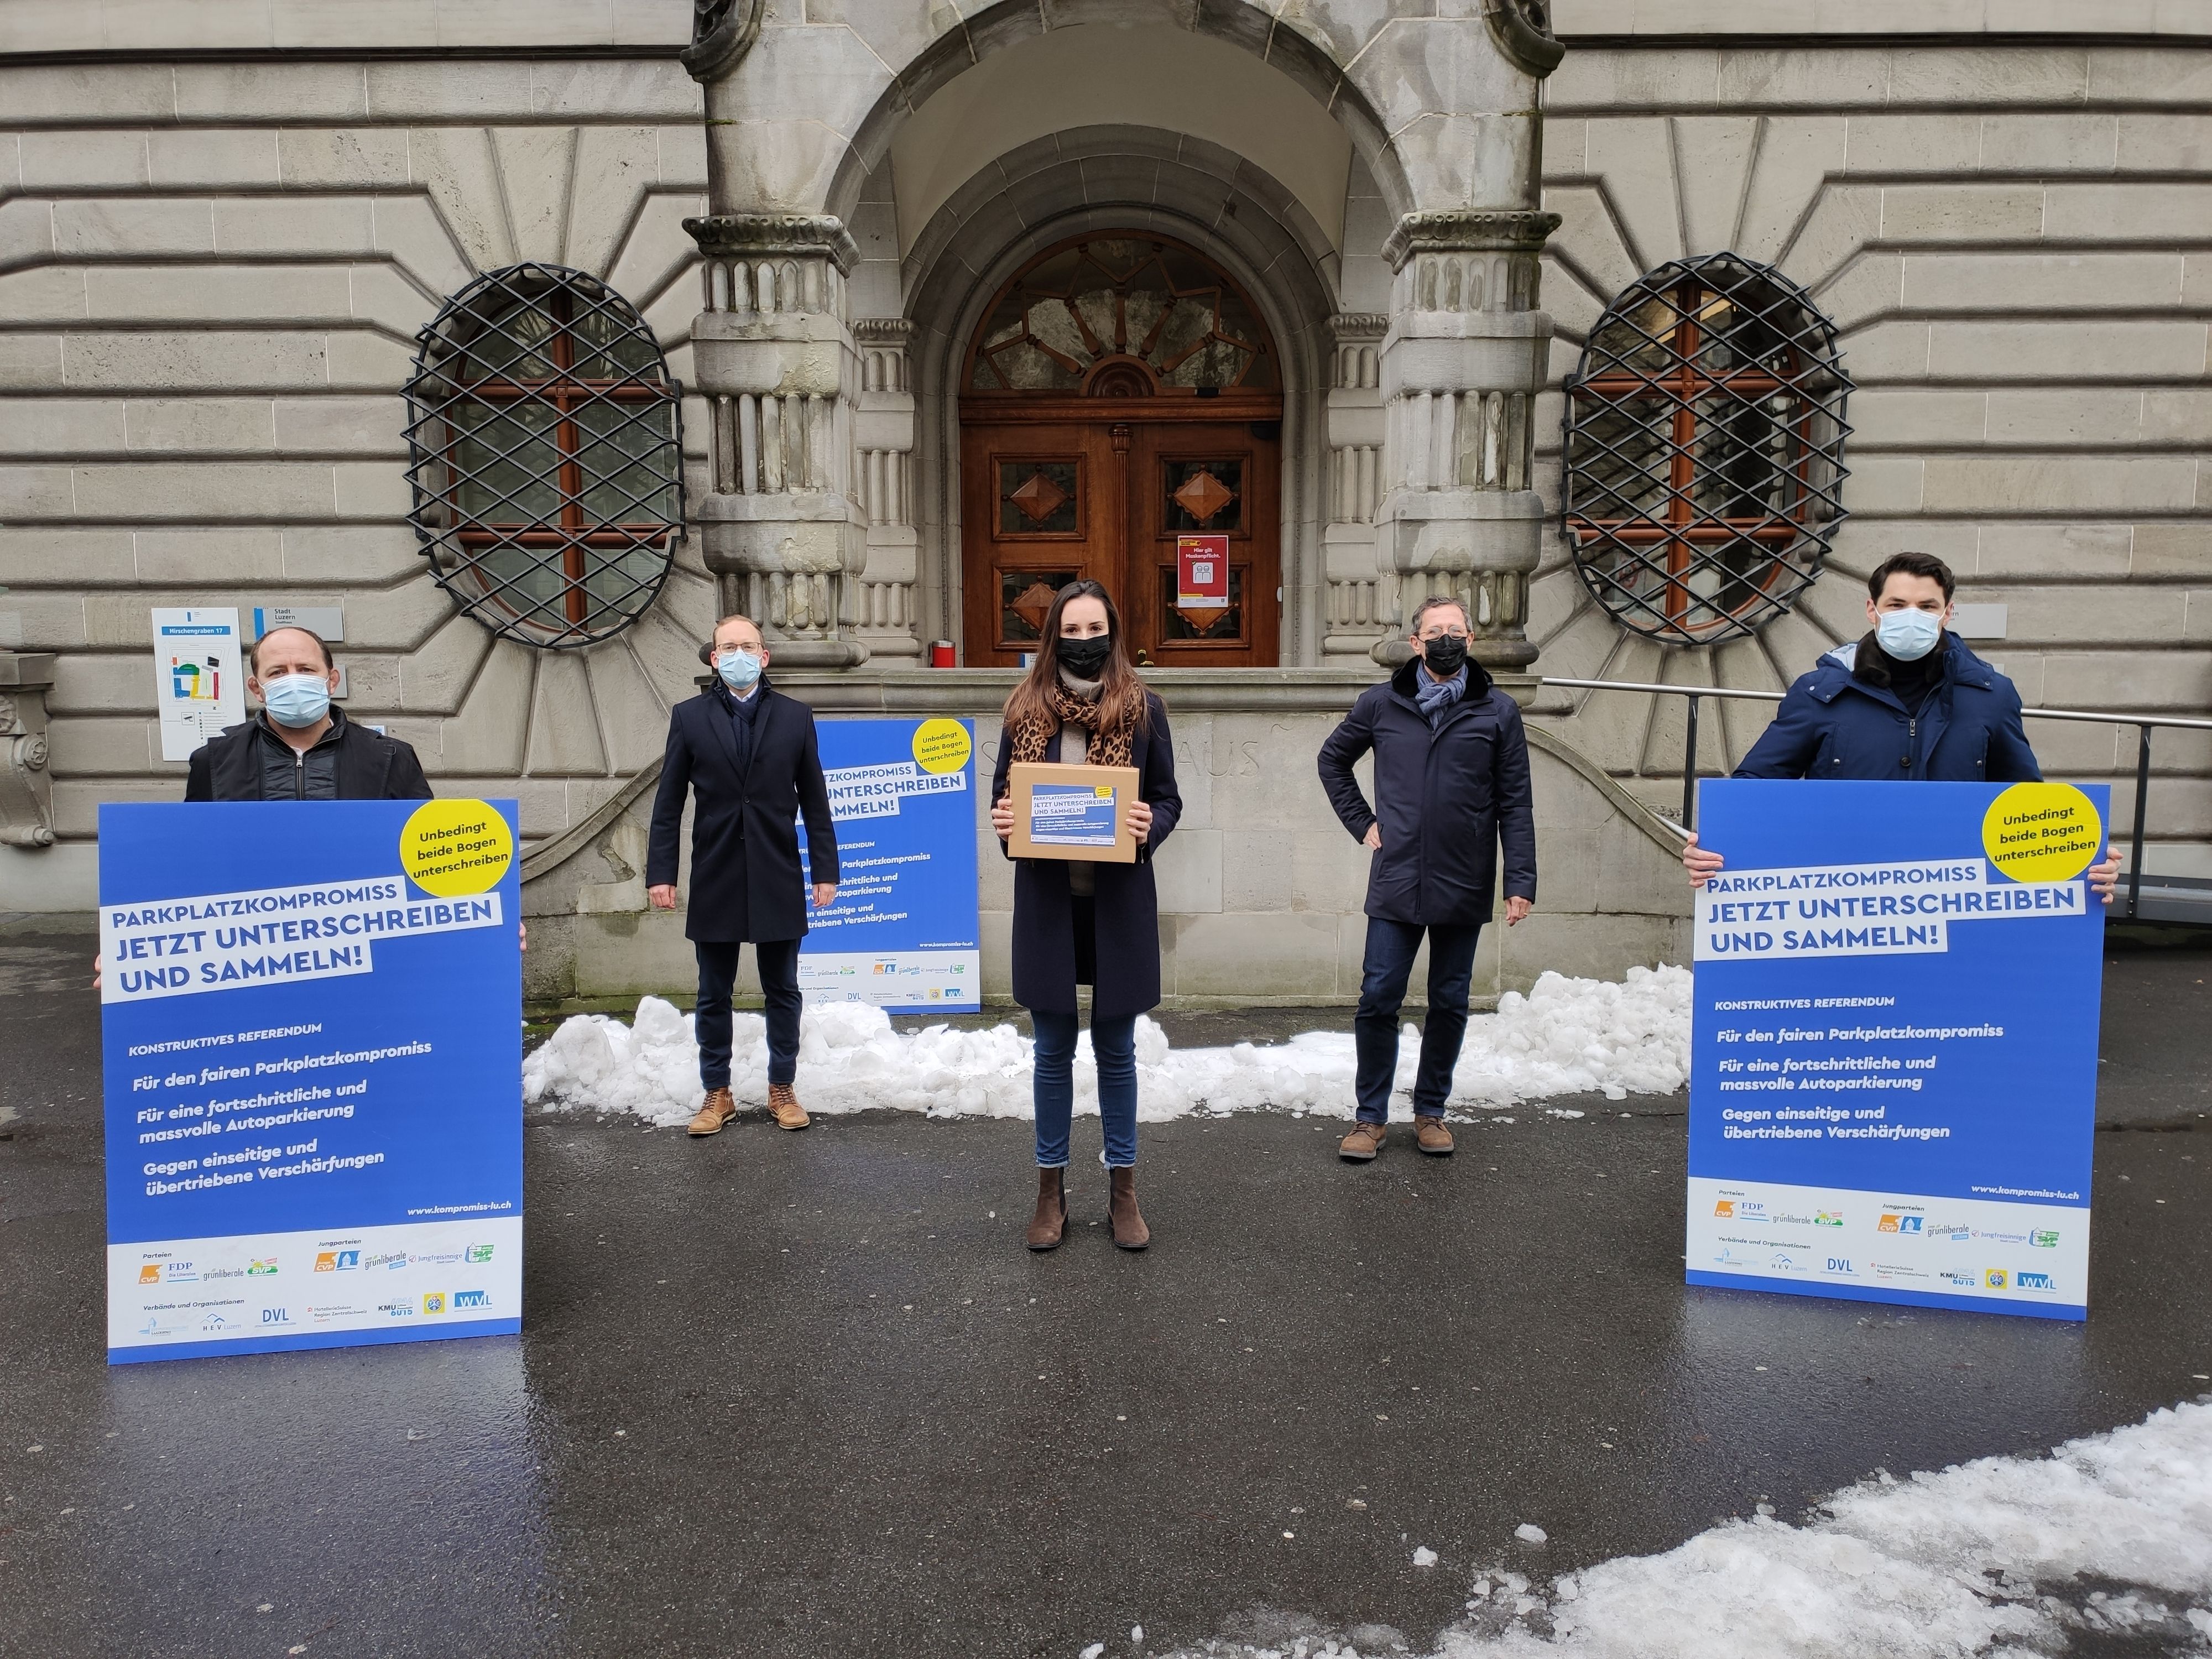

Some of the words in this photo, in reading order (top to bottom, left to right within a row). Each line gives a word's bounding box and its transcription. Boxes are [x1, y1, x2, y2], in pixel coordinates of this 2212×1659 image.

[923, 732, 957, 743] Unbedingt
[920, 748, 968, 763] unterschreiben
[922, 745, 939, 753] beide
[2004, 807, 2074, 825] Unbedingt
[420, 822, 487, 842] Unbedingt
[2001, 830, 2037, 843] beide
[2042, 825, 2083, 841] Bogen
[418, 846, 452, 860] beide
[457, 839, 496, 852] Bogen
[837, 841, 875, 850] EFERENDUM
[1994, 837, 2096, 862] unterschreiben
[414, 851, 508, 878] unterschreiben
[842, 853, 930, 868] Parkplatzkompromiss
[883, 873, 898, 881] und
[1708, 867, 1976, 893] PARKPLATZKOMPROMISS
[113, 884, 397, 928] PARKPLATZKOMPROMISS
[817, 906, 855, 916] einseitige
[858, 904, 873, 912] und
[1709, 901, 1790, 923] JETZT
[1799, 888, 2074, 919] UNTERSCHREIBEN
[117, 931, 206, 961] JETZT
[216, 897, 491, 948] UNTERSCHREIBEN
[808, 917, 842, 928] triebene
[844, 913, 907, 925] Verschärfungen
[1712, 932, 1773, 952] UND
[1783, 926, 1938, 950] SAMMELN!
[121, 967, 190, 992] UND
[201, 946, 362, 983] SAMMELN!
[1715, 999, 1811, 1010] KONSTRUKTIVES
[1814, 997, 1894, 1008] REFERENDUM
[129, 1035, 234, 1056] KONSTRUKTIVES
[238, 1023, 321, 1042] REFERENDUM
[1718, 1030, 1741, 1042] Für
[1745, 1029, 1773, 1042] den
[1777, 1028, 1824, 1044] fairen
[1829, 1024, 2003, 1042] Parkplatzkompromiss
[133, 1076, 160, 1091] Für
[165, 1073, 196, 1087] den
[200, 1066, 250, 1085] fairen
[255, 1041, 431, 1075] Parkplatzkompromiss
[1719, 1060, 1743, 1072] Für
[1747, 1058, 1779, 1071] eine
[1782, 1056, 1901, 1073] fortschrittliche
[1906, 1056, 1936, 1068] und
[1720, 1077, 1794, 1090] massvolle
[1798, 1076, 1922, 1092] Autoparkierung
[137, 1108, 164, 1123] Für
[169, 1104, 204, 1119] eine
[207, 1087, 331, 1117] fortschrittliche
[336, 1079, 367, 1095] und
[1723, 1109, 1771, 1123] Gegen
[1776, 1106, 1850, 1121] einseitige
[1855, 1106, 1885, 1119] und
[140, 1121, 221, 1144] massvolle
[226, 1103, 354, 1131] Autoparkierung
[1724, 1125, 1822, 1138] übertriebene
[1827, 1125, 1949, 1140] Verschärfungen
[144, 1160, 197, 1175] Gegen
[203, 1146, 281, 1167] einseitige
[286, 1139, 317, 1155] und
[147, 1172, 253, 1196] übertriebene
[257, 1148, 384, 1179] Verschärfungen
[1971, 1186, 2079, 1199] www.kompromiss-lu.ch
[408, 1201, 511, 1215] www.kompromiss-lu.ch
[1981, 1232, 2026, 1241] Jungfreisinnige
[1828, 1259, 1852, 1271] DVL
[2023, 1277, 2056, 1289] WVL
[460, 1295, 492, 1306] WVL
[263, 1308, 289, 1322] DVL
